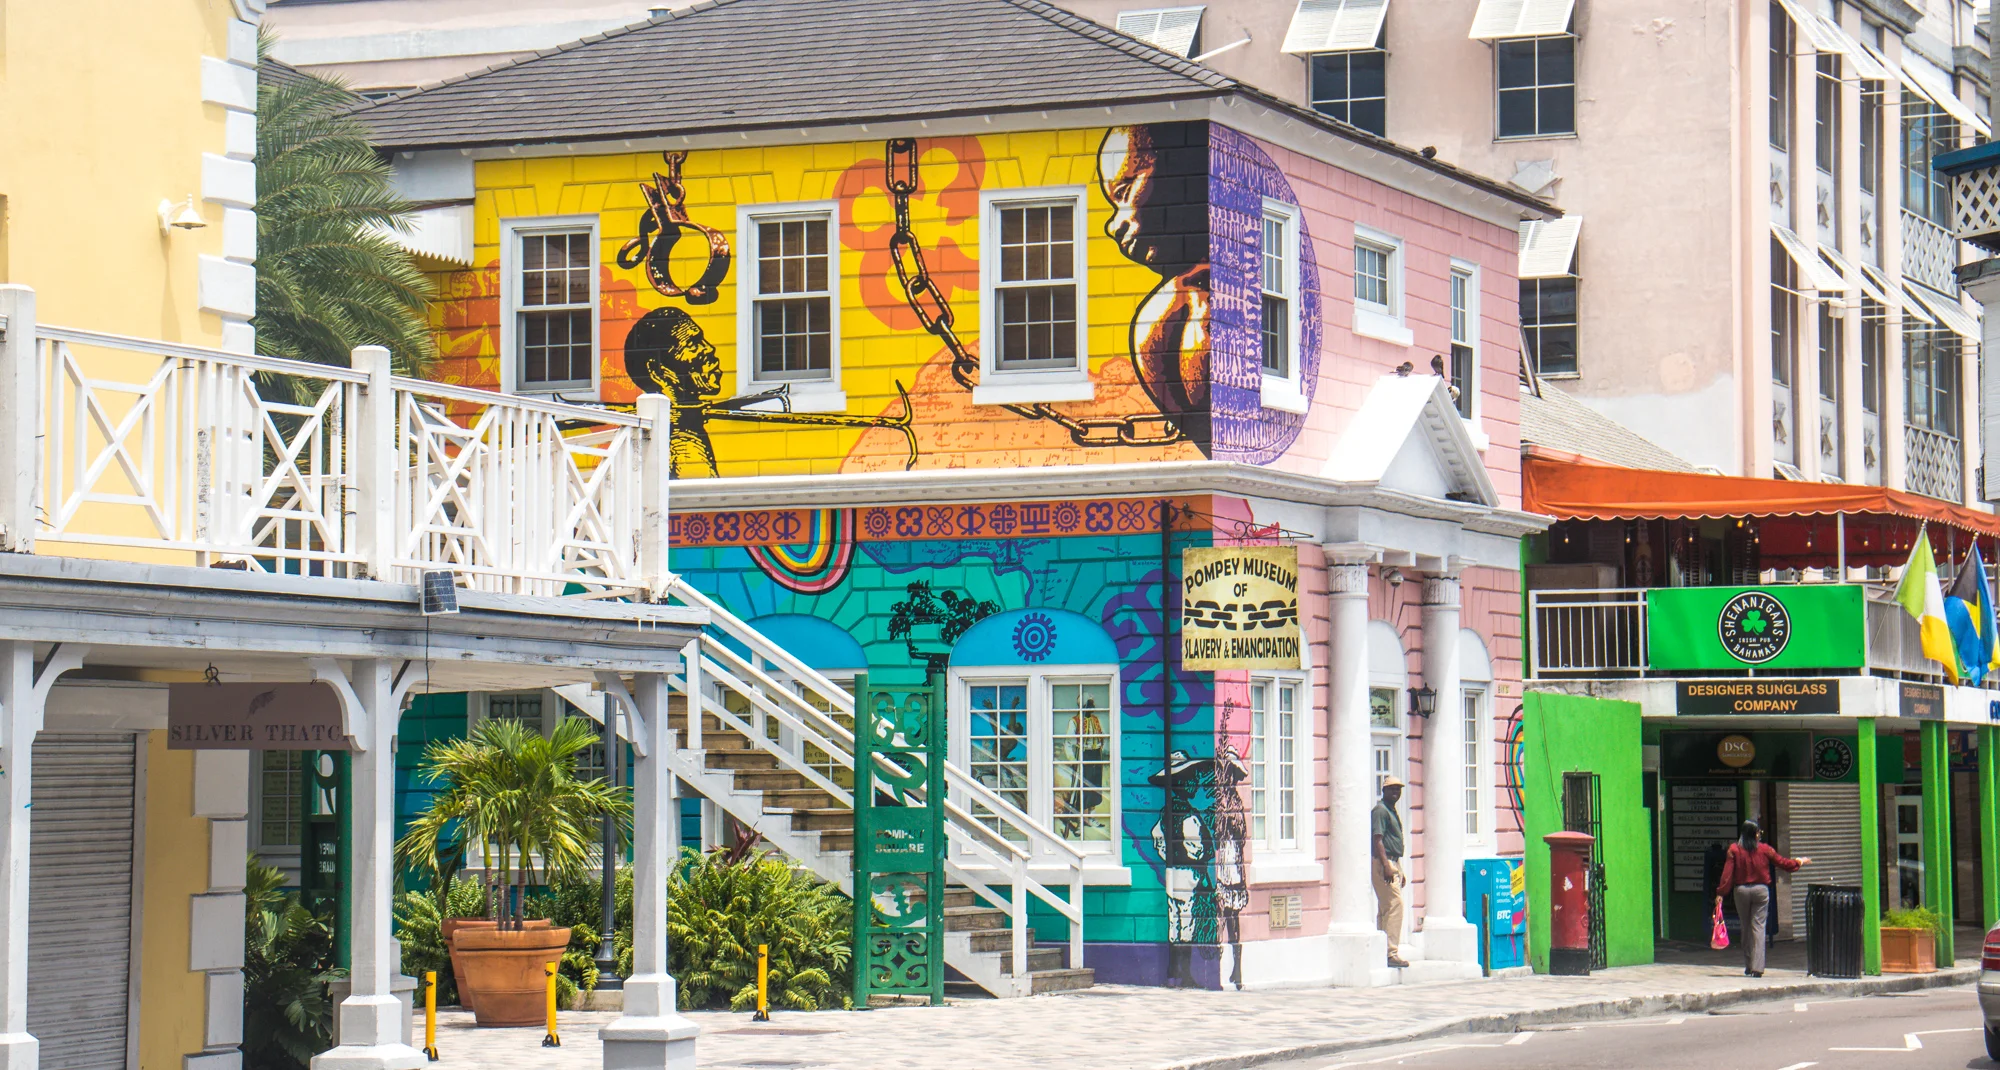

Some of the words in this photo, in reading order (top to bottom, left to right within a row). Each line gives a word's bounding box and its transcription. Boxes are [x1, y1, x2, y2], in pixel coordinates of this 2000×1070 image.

[1185, 557, 1240, 594] POMPEY
[1243, 557, 1298, 594] MUSEUM
[1233, 582, 1248, 597] OF
[1724, 596, 1785, 637] SHENANIGANS
[1185, 637, 1222, 659] SLAVERY
[1223, 641, 1230, 659] &
[1231, 636, 1299, 659] EMANCIPATION
[1733, 643, 1776, 659] BAHAMAS
[1688, 684, 1753, 696] DESIGNER
[1756, 683, 1827, 695] SUNGLASS
[1734, 699, 1798, 711] COMPANY
[171, 724, 254, 741] SILVER
[265, 724, 350, 741] THATC
[1724, 742, 1749, 751] DSC
[875, 843, 925, 853] SQUARE
[1497, 909, 1512, 920] BTC
